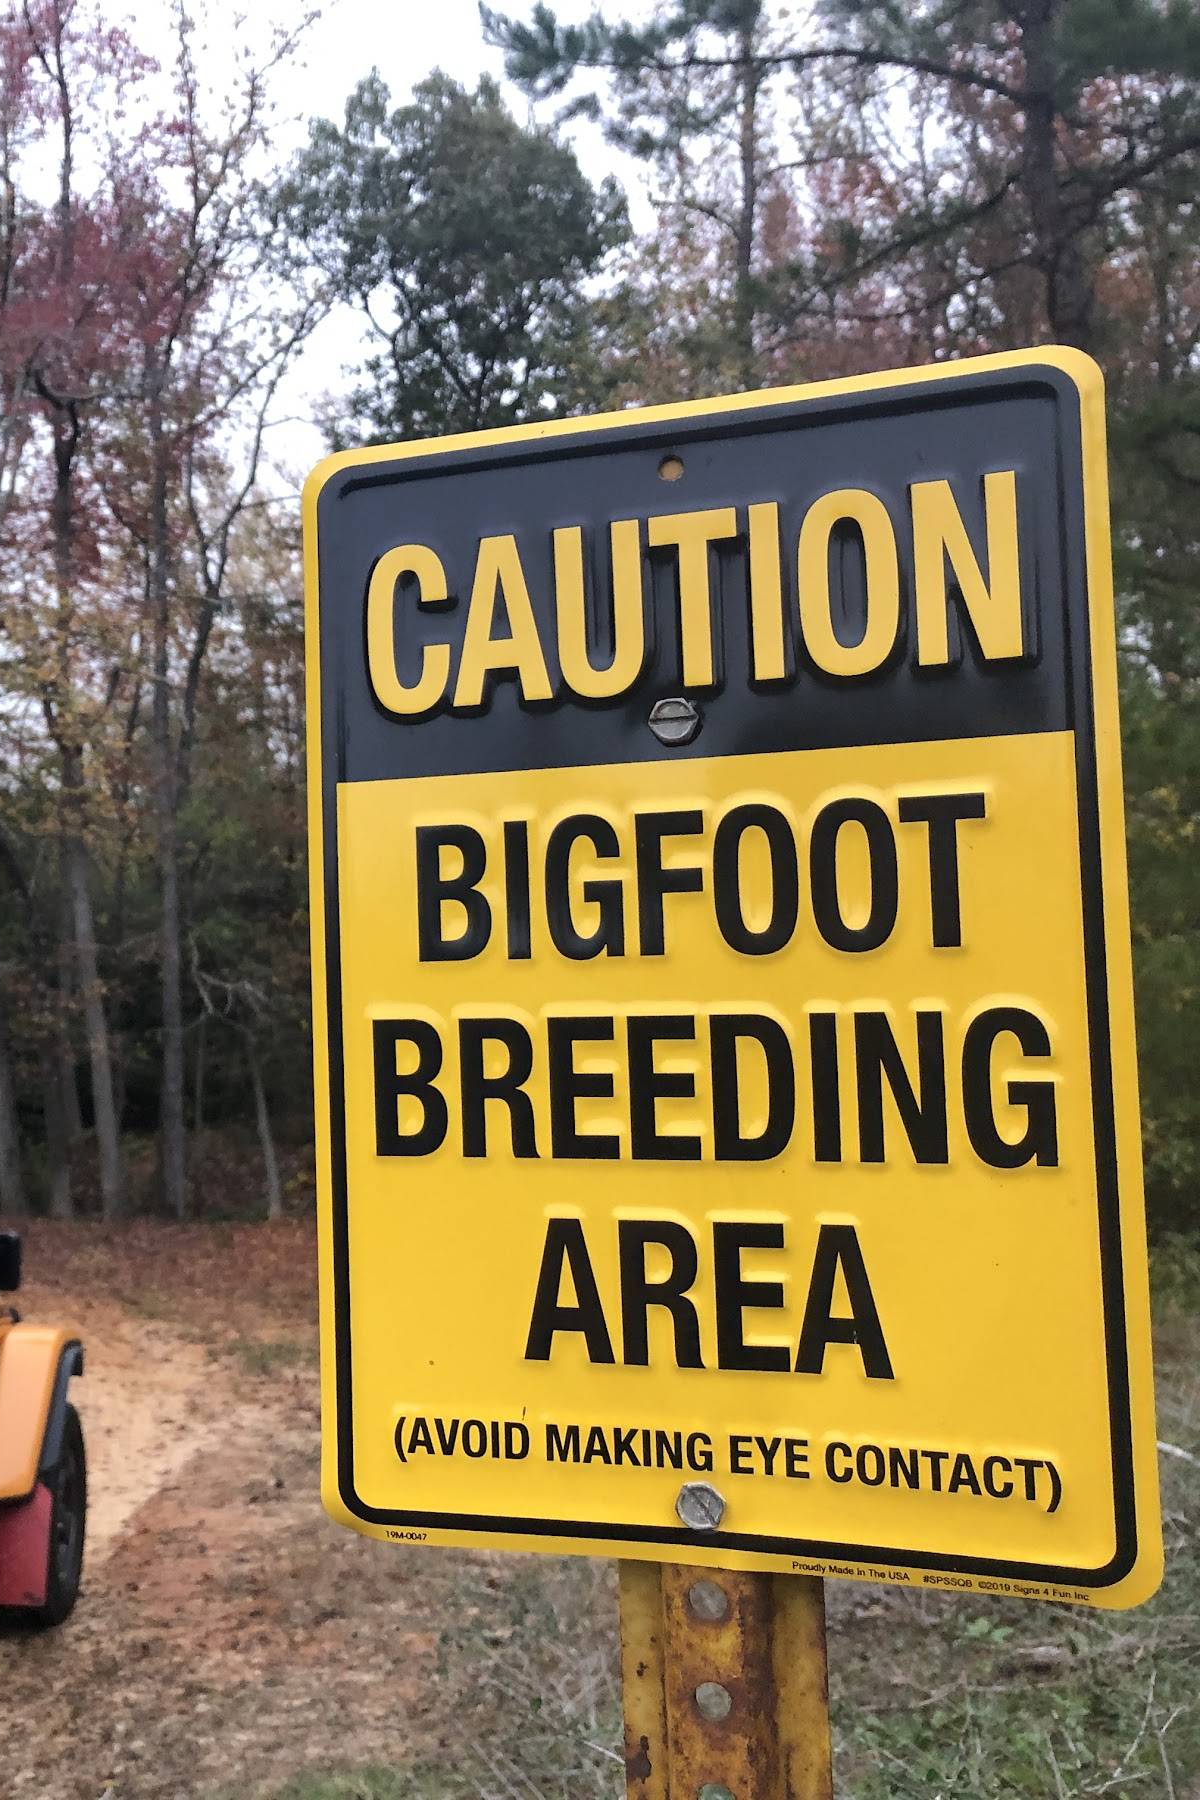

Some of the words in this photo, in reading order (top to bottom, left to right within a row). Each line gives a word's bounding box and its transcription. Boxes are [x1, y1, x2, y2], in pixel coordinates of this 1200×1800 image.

[366, 470, 1024, 716] CAUTION
[415, 792, 986, 962] BIGFOOT
[372, 1007, 1059, 1168] BREEDING
[524, 1218, 896, 1380] AREA
[394, 1416, 530, 1463] (AVOID
[546, 1423, 714, 1472] MAKING
[729, 1435, 810, 1479] EYE
[825, 1441, 1062, 1513] CONTACT)
[792, 1561, 826, 1574] Proudly
[829, 1565, 854, 1575] Made
[857, 1568, 866, 1576] In
[869, 1569, 886, 1579] The
[888, 1572, 910, 1581] USA
[1013, 1585, 1040, 1596] Signs
[1043, 1587, 1050, 1596] 4
[1052, 1589, 1072, 1599] Fun
